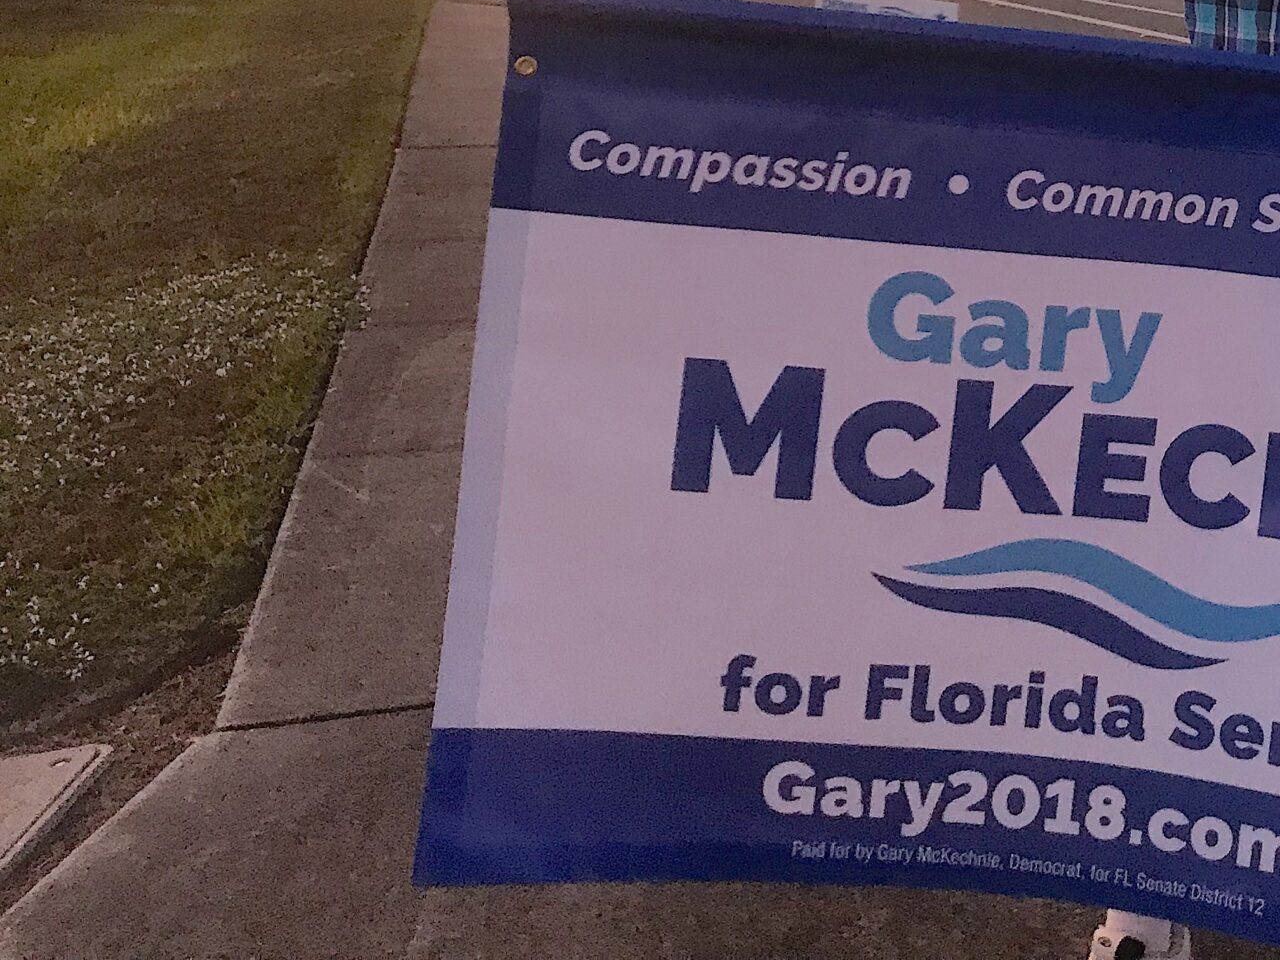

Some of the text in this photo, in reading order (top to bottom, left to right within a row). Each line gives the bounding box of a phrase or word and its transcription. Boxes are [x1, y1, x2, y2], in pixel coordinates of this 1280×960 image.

[568, 130, 912, 200] Compassion
[1006, 170, 1238, 230] Common
[867, 270, 1162, 403] Gary
[721, 654, 841, 718] for
[865, 663, 1146, 742] Florida
[791, 841, 825, 858] Paid
[829, 843, 850, 859] for
[855, 844, 874, 863] by
[877, 844, 913, 864] Gary
[1009, 853, 1085, 880] Democrat,
[1090, 865, 1110, 883] for
[1114, 869, 1132, 888] FL
[1137, 872, 1187, 897] Senate
[1190, 883, 1243, 908] District
[1249, 898, 1266, 917] 12
